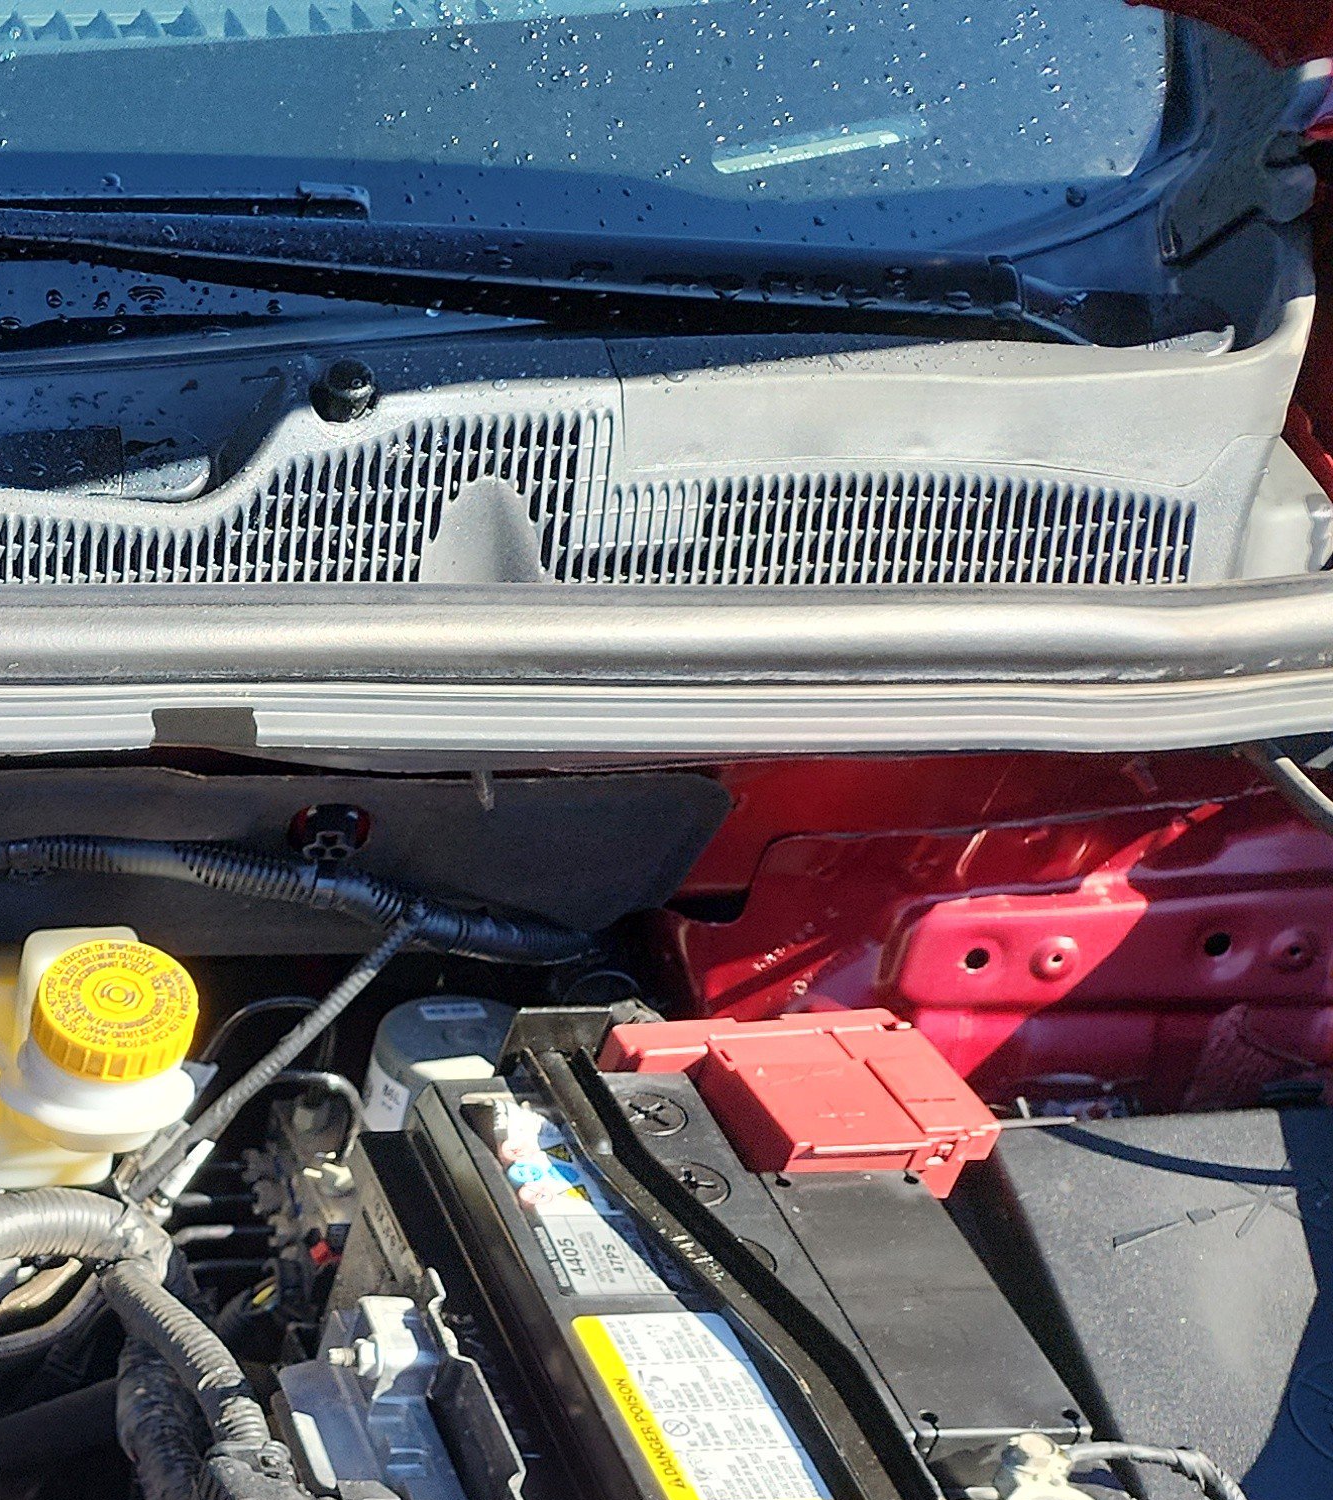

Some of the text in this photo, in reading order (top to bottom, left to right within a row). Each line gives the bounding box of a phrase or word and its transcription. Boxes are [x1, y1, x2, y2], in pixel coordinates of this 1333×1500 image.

[557, 1238, 586, 1276] 4405
[602, 1244, 625, 1273] 47PS
[613, 1378, 679, 1476] DANGER POISON
